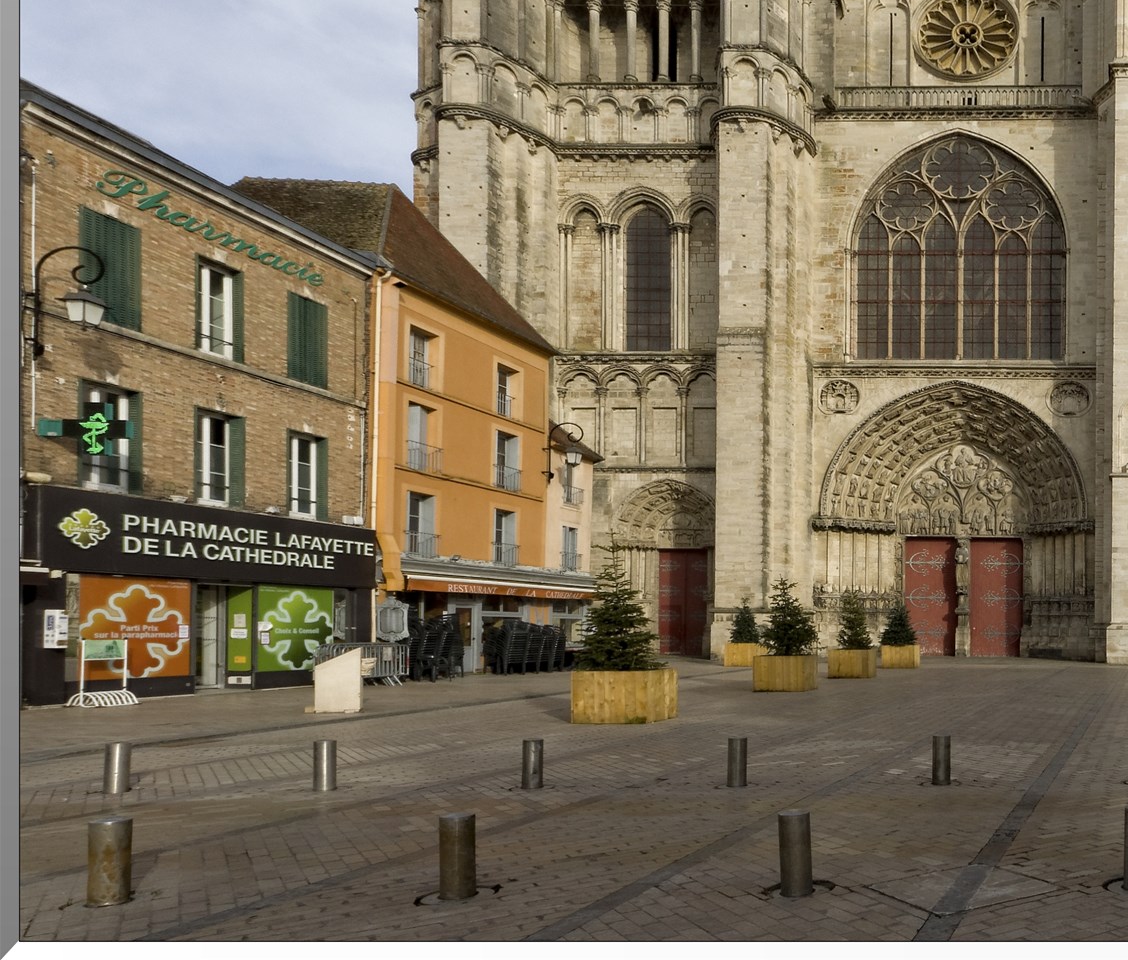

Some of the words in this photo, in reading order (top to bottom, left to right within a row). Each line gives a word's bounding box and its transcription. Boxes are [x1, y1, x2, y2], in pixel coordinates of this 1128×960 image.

[96, 169, 324, 286] Pharmacie
[122, 514, 268, 545] PHARMACIE
[275, 532, 374, 557] LAFAYETTE
[122, 536, 159, 556] DE
[165, 540, 198, 559] LA
[203, 543, 335, 570] CATHEDRALE
[447, 583, 498, 595] RESTAURANT
[506, 587, 516, 596] DE
[525, 589, 536, 598] LA
[120, 624, 140, 632] Parti
[142, 624, 159, 632] Prix
[121, 632, 178, 640] parapharmaci
